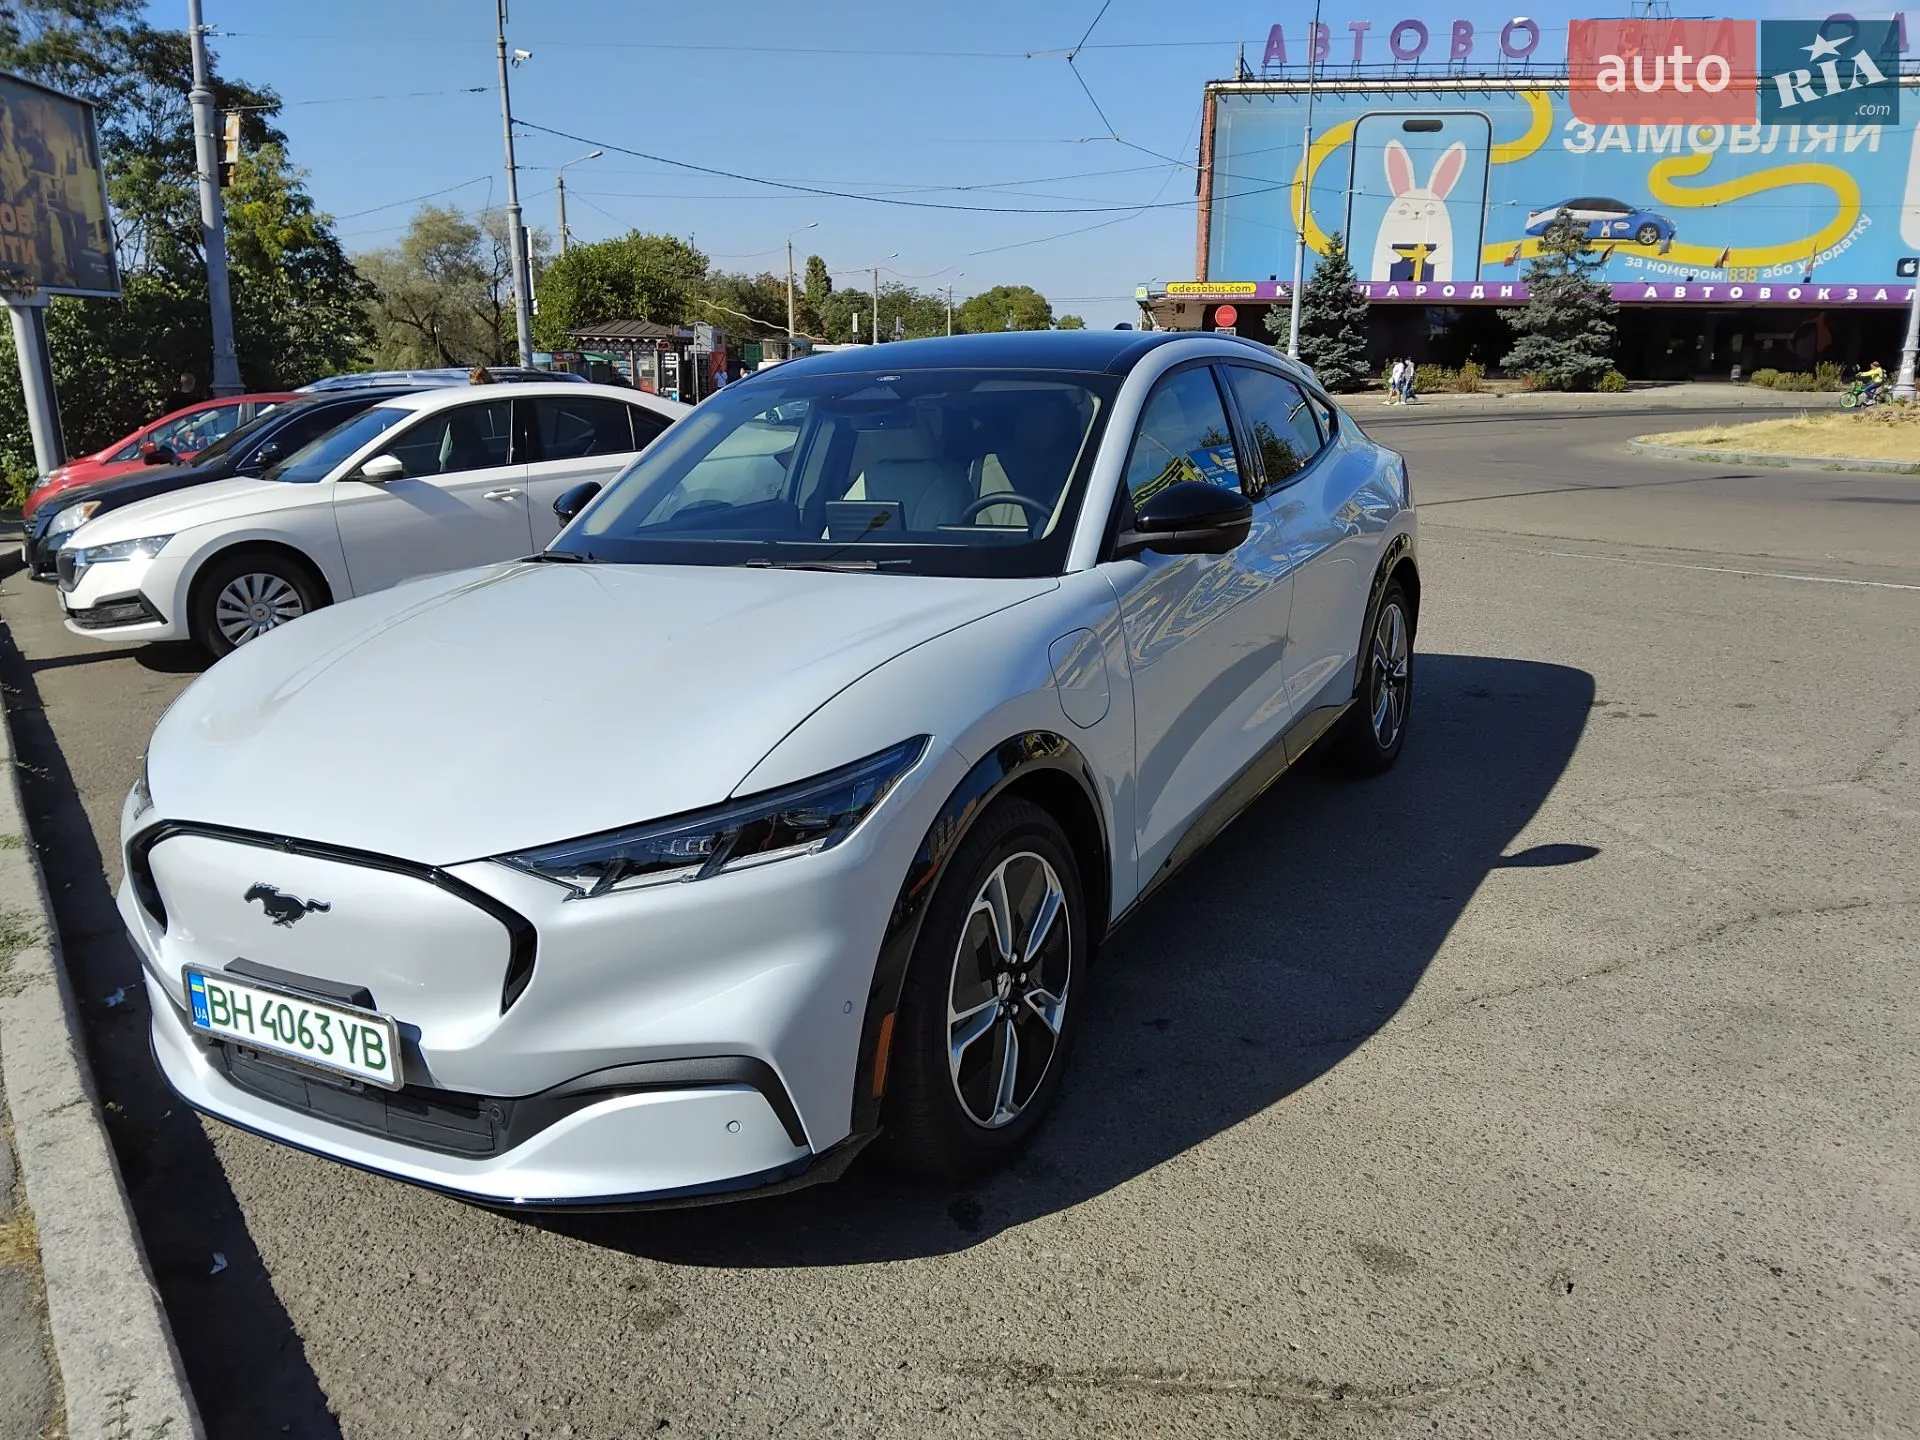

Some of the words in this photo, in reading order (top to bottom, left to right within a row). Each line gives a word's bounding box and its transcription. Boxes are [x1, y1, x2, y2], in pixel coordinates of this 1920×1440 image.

[1624, 256, 1644, 268] за
[1646, 262, 1723, 281] номером
[1728, 267, 1757, 283] 838
[1762, 264, 1793, 279] або
[1812, 213, 1872, 268] додатку
[1172, 284, 1252, 293] odessabus.com
[194, 1006, 209, 1021] UA
[207, 983, 255, 1036] BH
[260, 999, 334, 1056] 4063
[338, 1019, 387, 1071] YB
